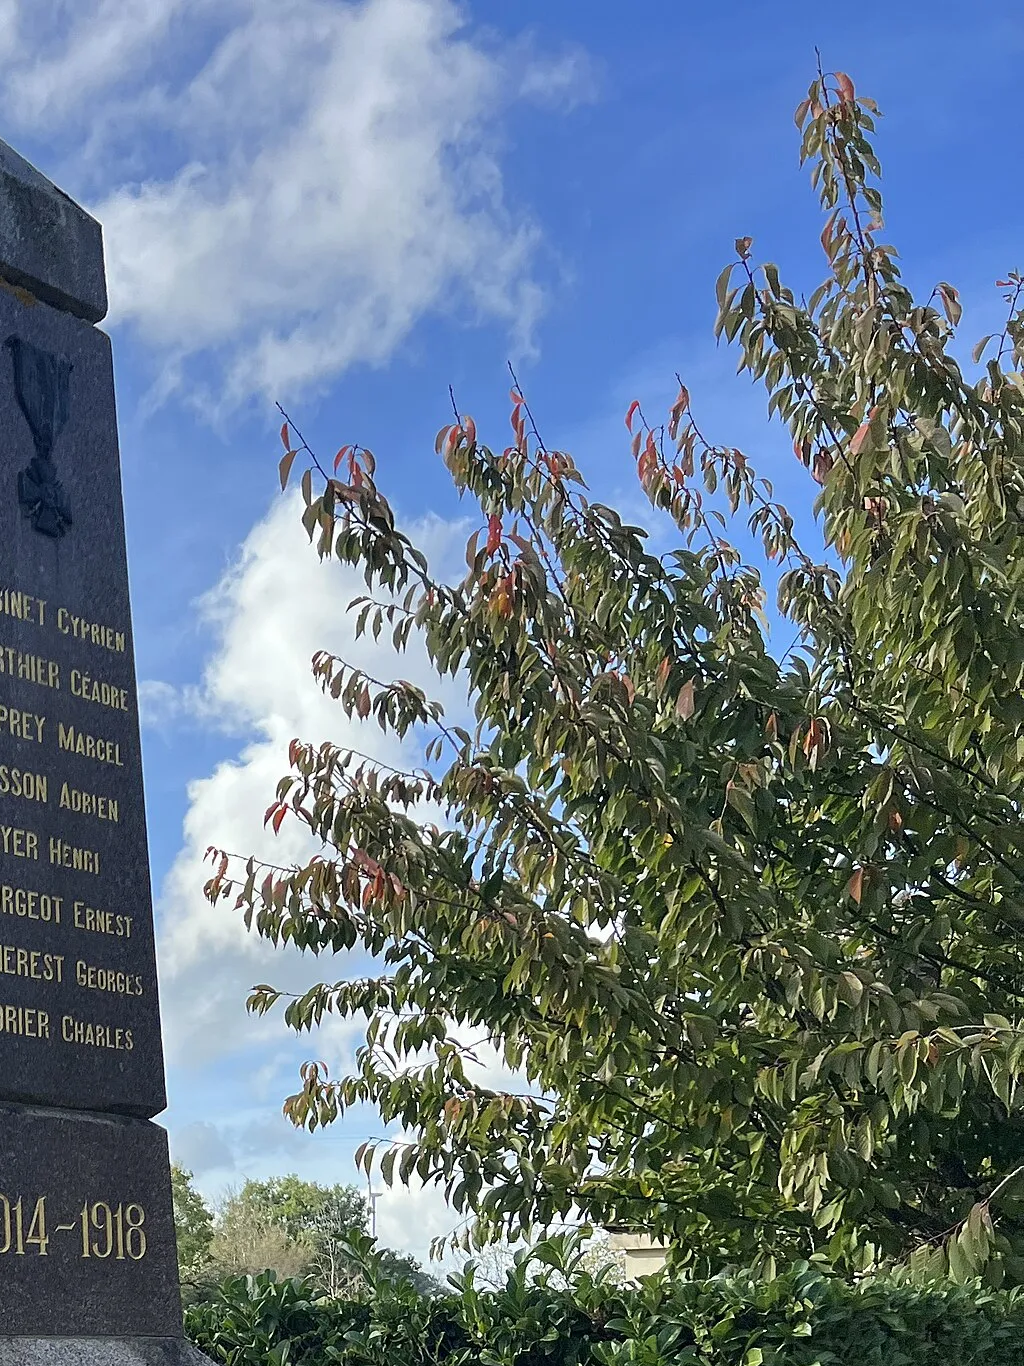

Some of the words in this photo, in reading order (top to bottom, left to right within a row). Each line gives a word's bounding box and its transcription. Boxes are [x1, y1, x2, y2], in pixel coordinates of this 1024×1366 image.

[57, 607, 125, 653] CYPRIEN
[58, 722, 124, 767] MARCEL
[59, 781, 119, 823] ADRIEN
[49, 837, 100, 875] HENRI
[73, 901, 133, 938] ERNEST
[76, 960, 143, 996] GEORGES
[61, 1015, 134, 1050] CHARLES
